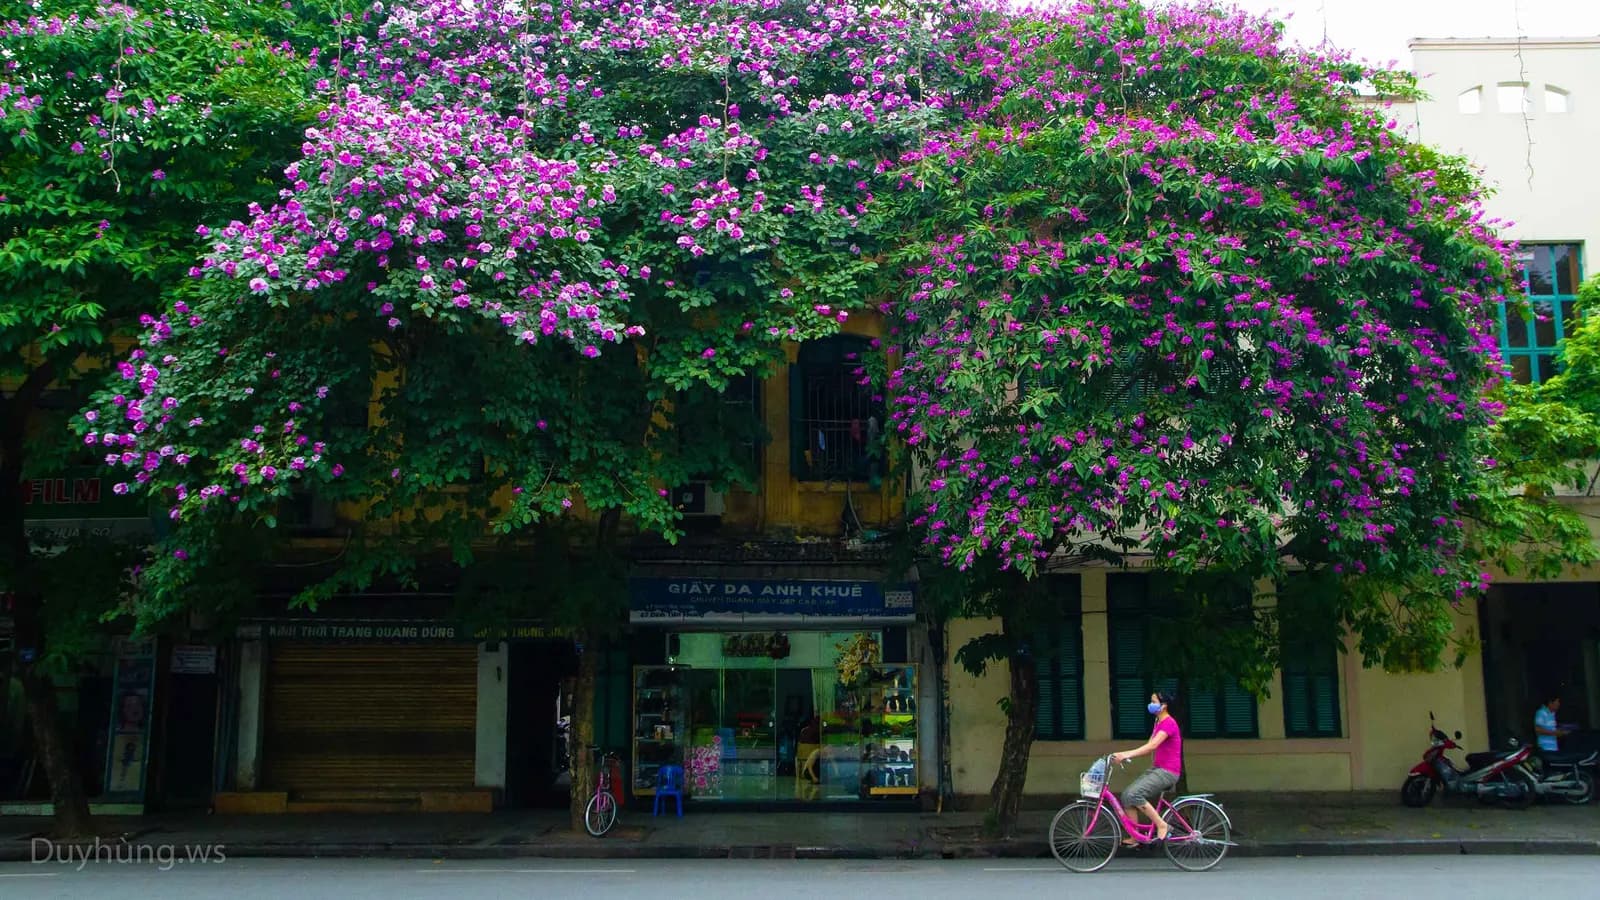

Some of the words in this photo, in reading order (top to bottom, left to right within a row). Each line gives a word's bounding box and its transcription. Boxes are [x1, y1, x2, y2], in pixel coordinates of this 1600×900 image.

[24, 477, 102, 504] FILM
[724, 583, 753, 595] DA
[760, 584, 803, 596] ANH
[811, 584, 863, 597] KHUÊ
[330, 625, 373, 638] TRANG
[376, 625, 418, 639] QUANG
